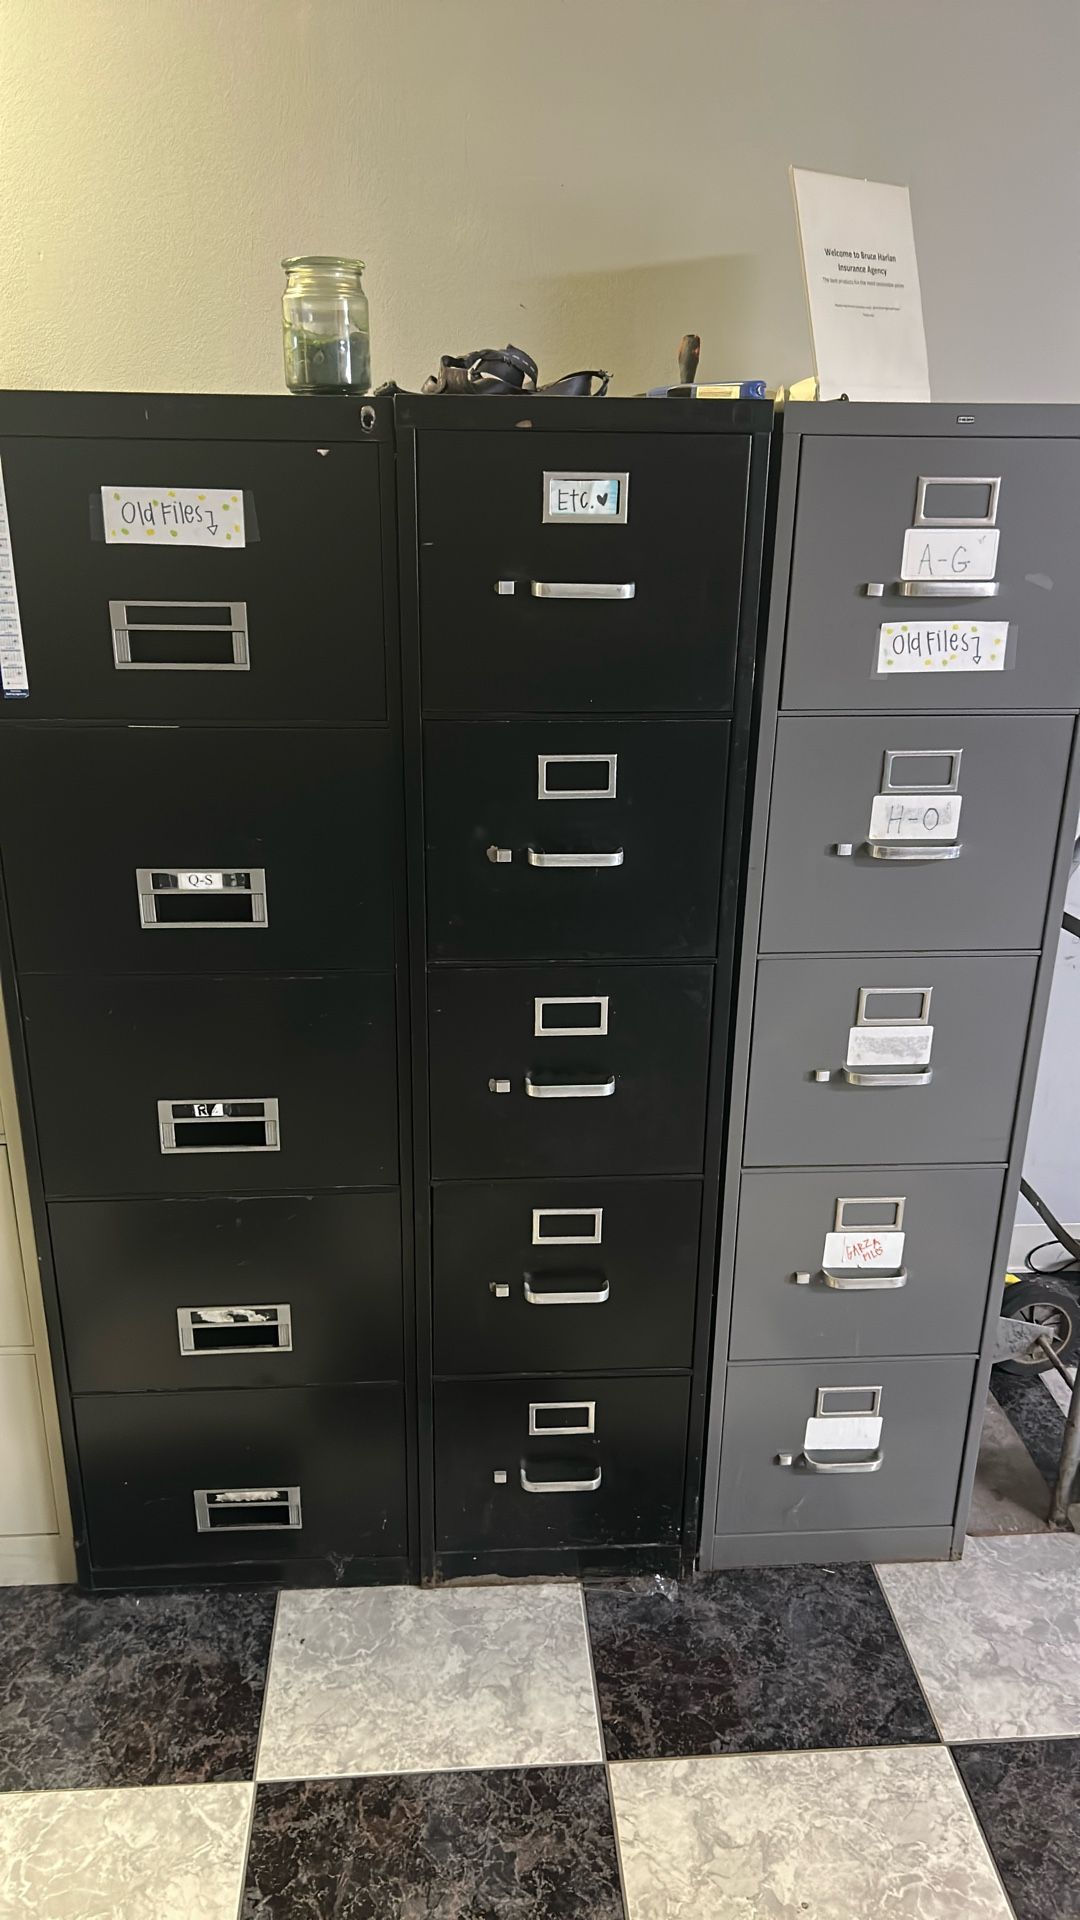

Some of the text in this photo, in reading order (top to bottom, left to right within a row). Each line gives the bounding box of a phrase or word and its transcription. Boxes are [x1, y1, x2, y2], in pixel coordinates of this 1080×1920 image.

[824, 248, 896, 262] Welcome to Bruce Harlan
[838, 264, 887, 277] Insurance Agency
[558, 489, 594, 512] Etc.
[121, 501, 203, 526] Old Files
[892, 629, 969, 657] Old Files
[188, 874, 213, 887] Q-S
